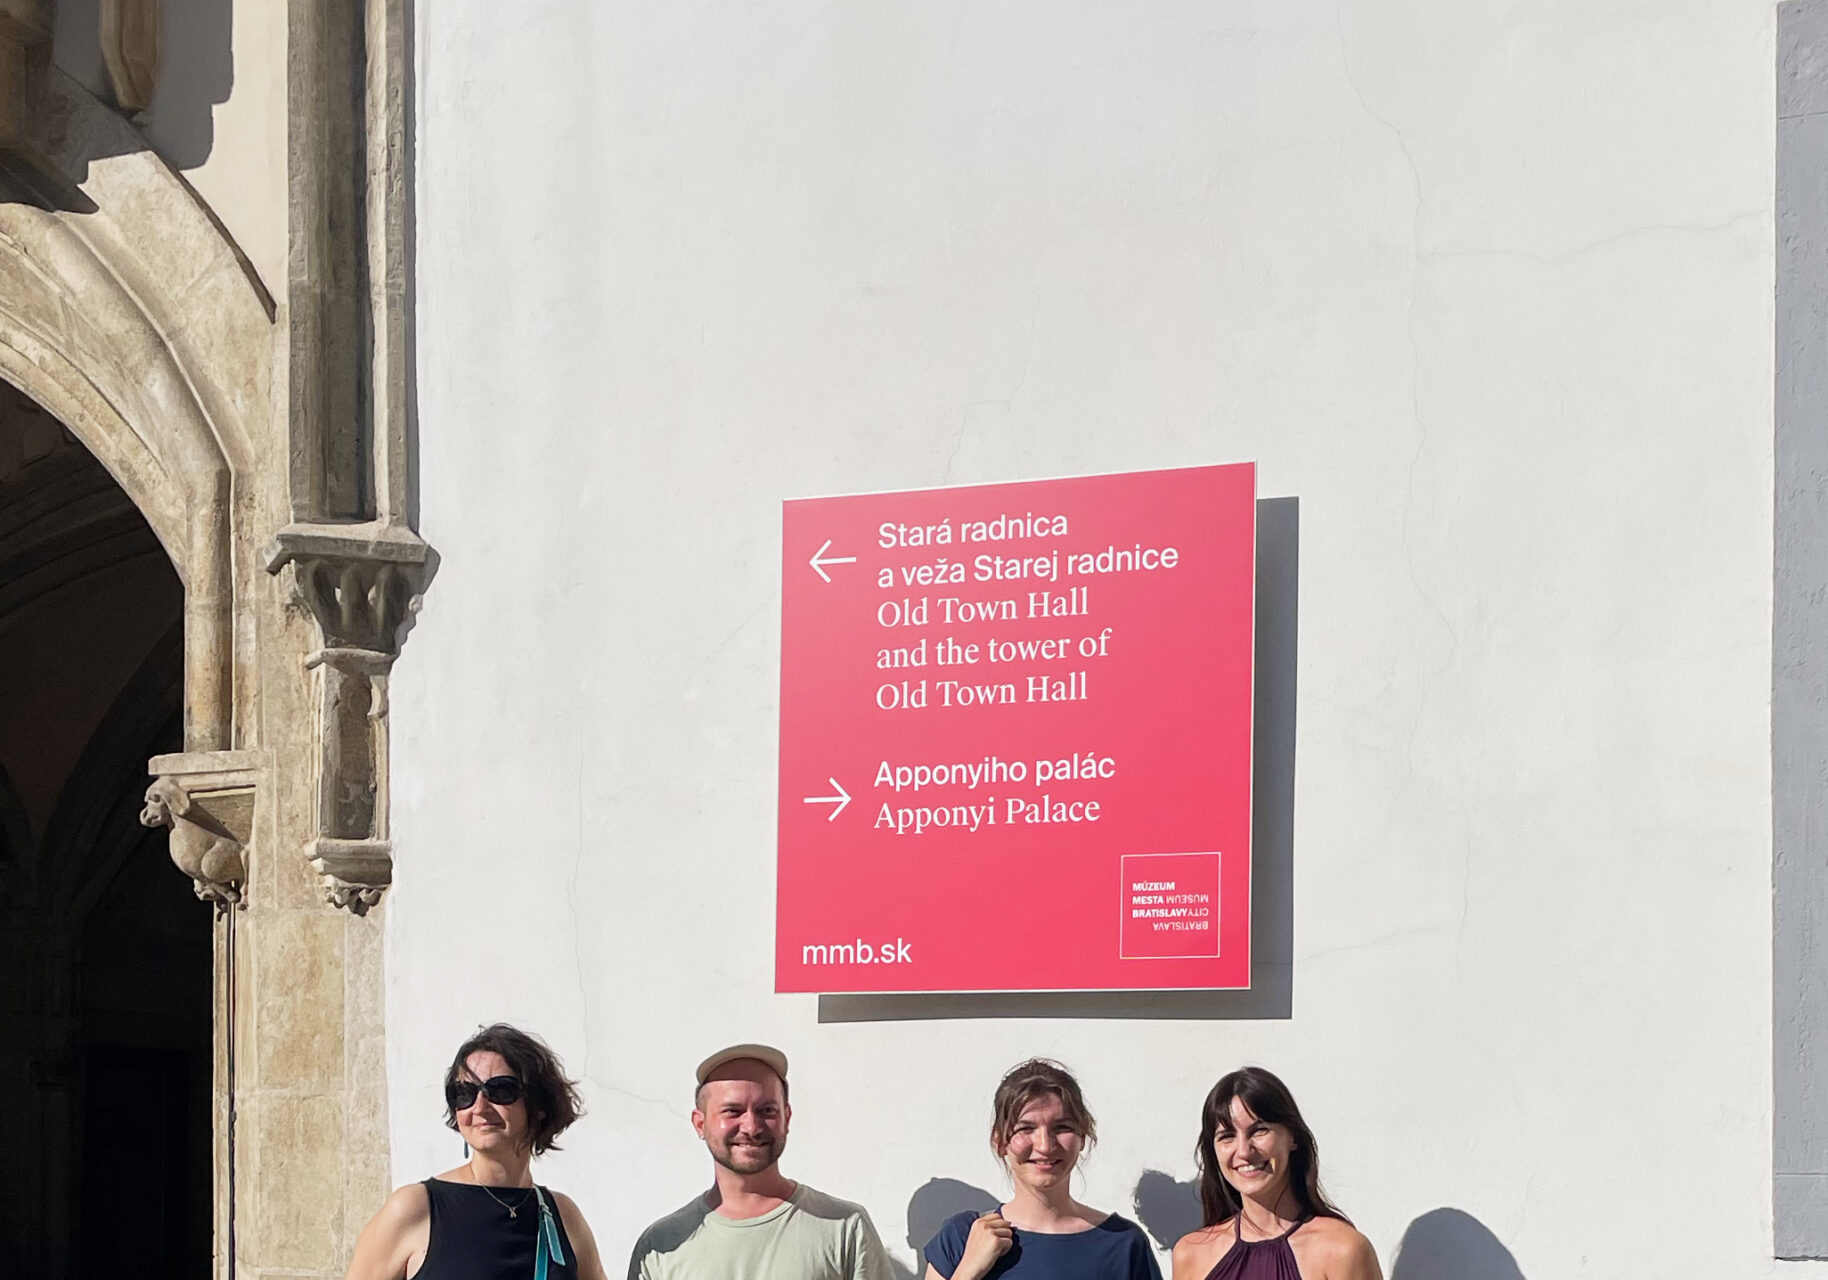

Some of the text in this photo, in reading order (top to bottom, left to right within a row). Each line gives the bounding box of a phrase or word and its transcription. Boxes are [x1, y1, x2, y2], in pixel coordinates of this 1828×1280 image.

[878, 511, 1068, 549] Stará radnica
[877, 543, 1179, 588] a veža Starej radnice
[877, 586, 1089, 628] Old Town Hall
[876, 627, 1113, 669] and the tower of
[876, 670, 1087, 710] Old Town Hall
[873, 751, 1116, 793] Apponyiho palác
[873, 793, 1101, 835] Apponyi Palace
[1132, 881, 1175, 891] MÚZEUM
[1132, 896, 1164, 904] MESTA
[1166, 894, 1209, 903] MUSEUM
[1132, 908, 1187, 918] BRATISLAVY
[1153, 921, 1208, 930] BRATISLAVA
[802, 937, 913, 965] mmb.sk
